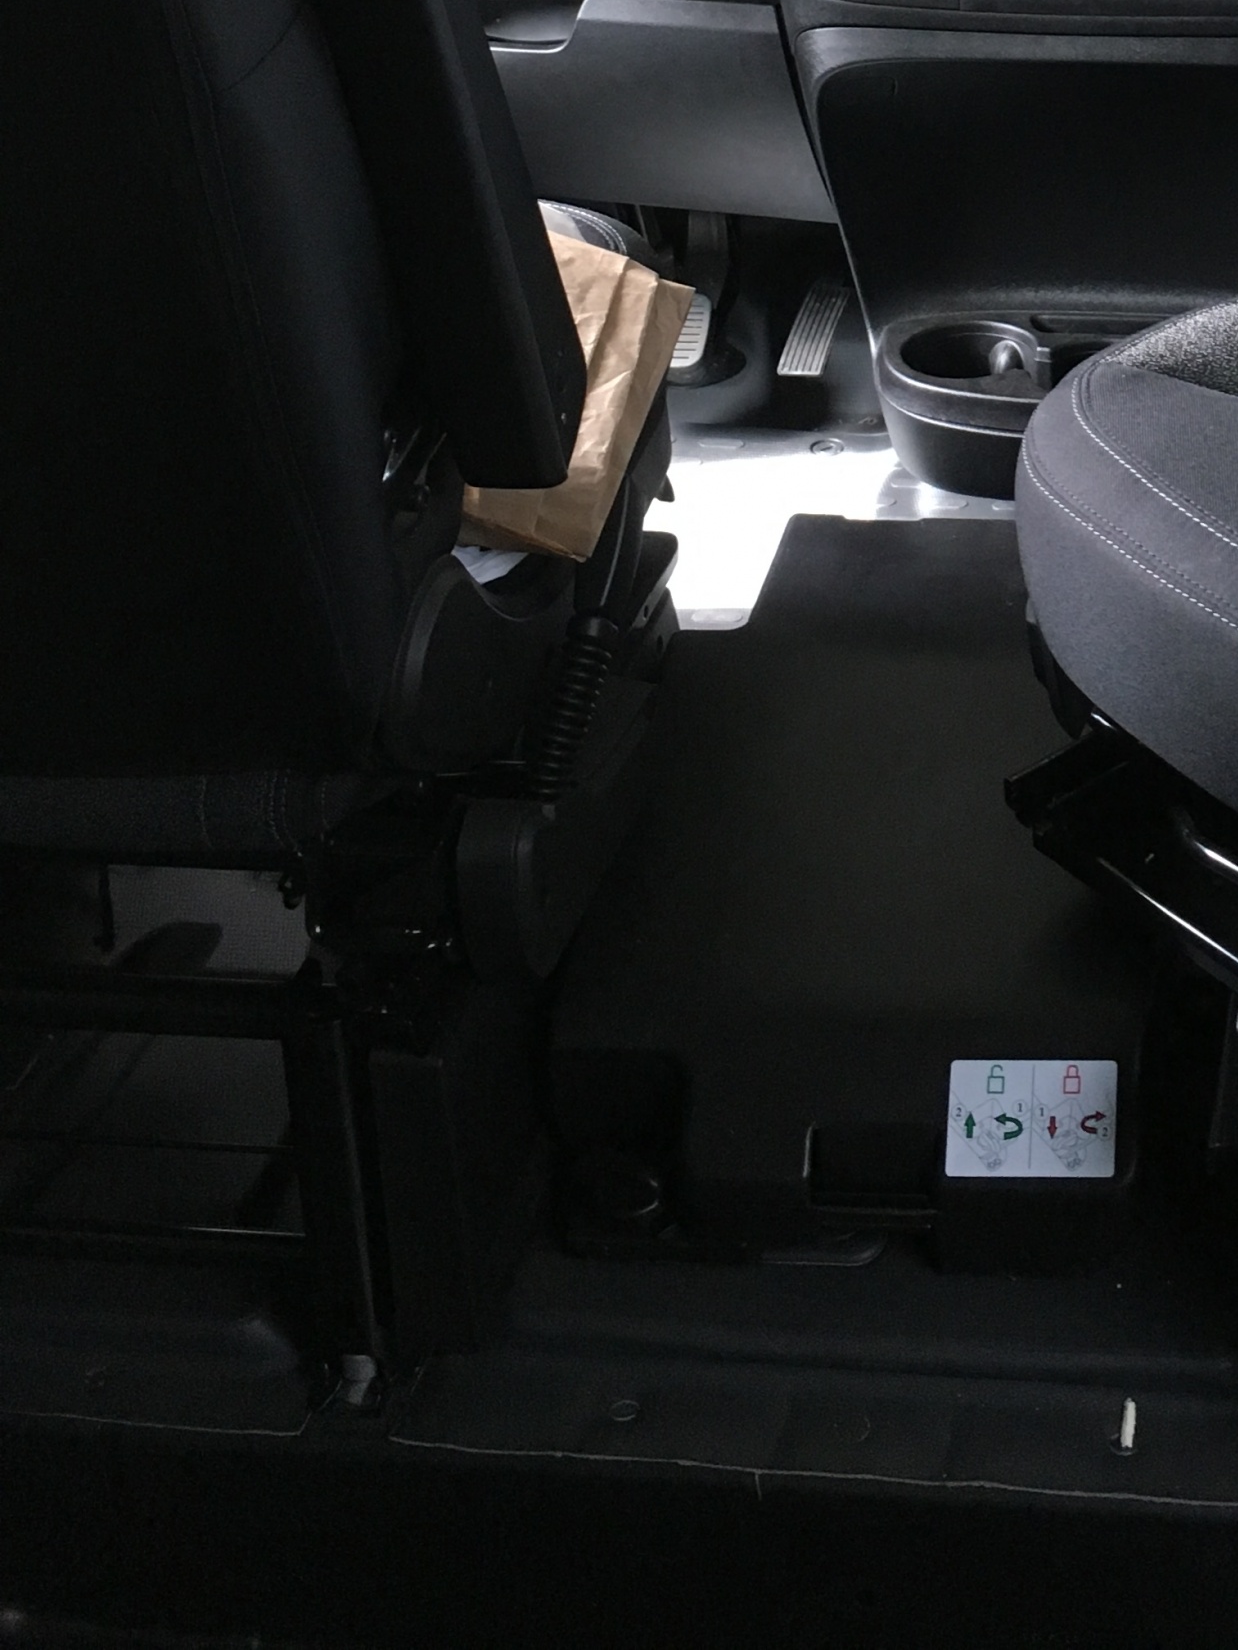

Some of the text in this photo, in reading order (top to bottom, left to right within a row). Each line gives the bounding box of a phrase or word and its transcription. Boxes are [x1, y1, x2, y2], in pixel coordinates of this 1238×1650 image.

[955, 1107, 962, 1117] 2
[1017, 1102, 1023, 1113] 1
[1038, 1107, 1045, 1117] 1
[1102, 1127, 1108, 1137] 2
